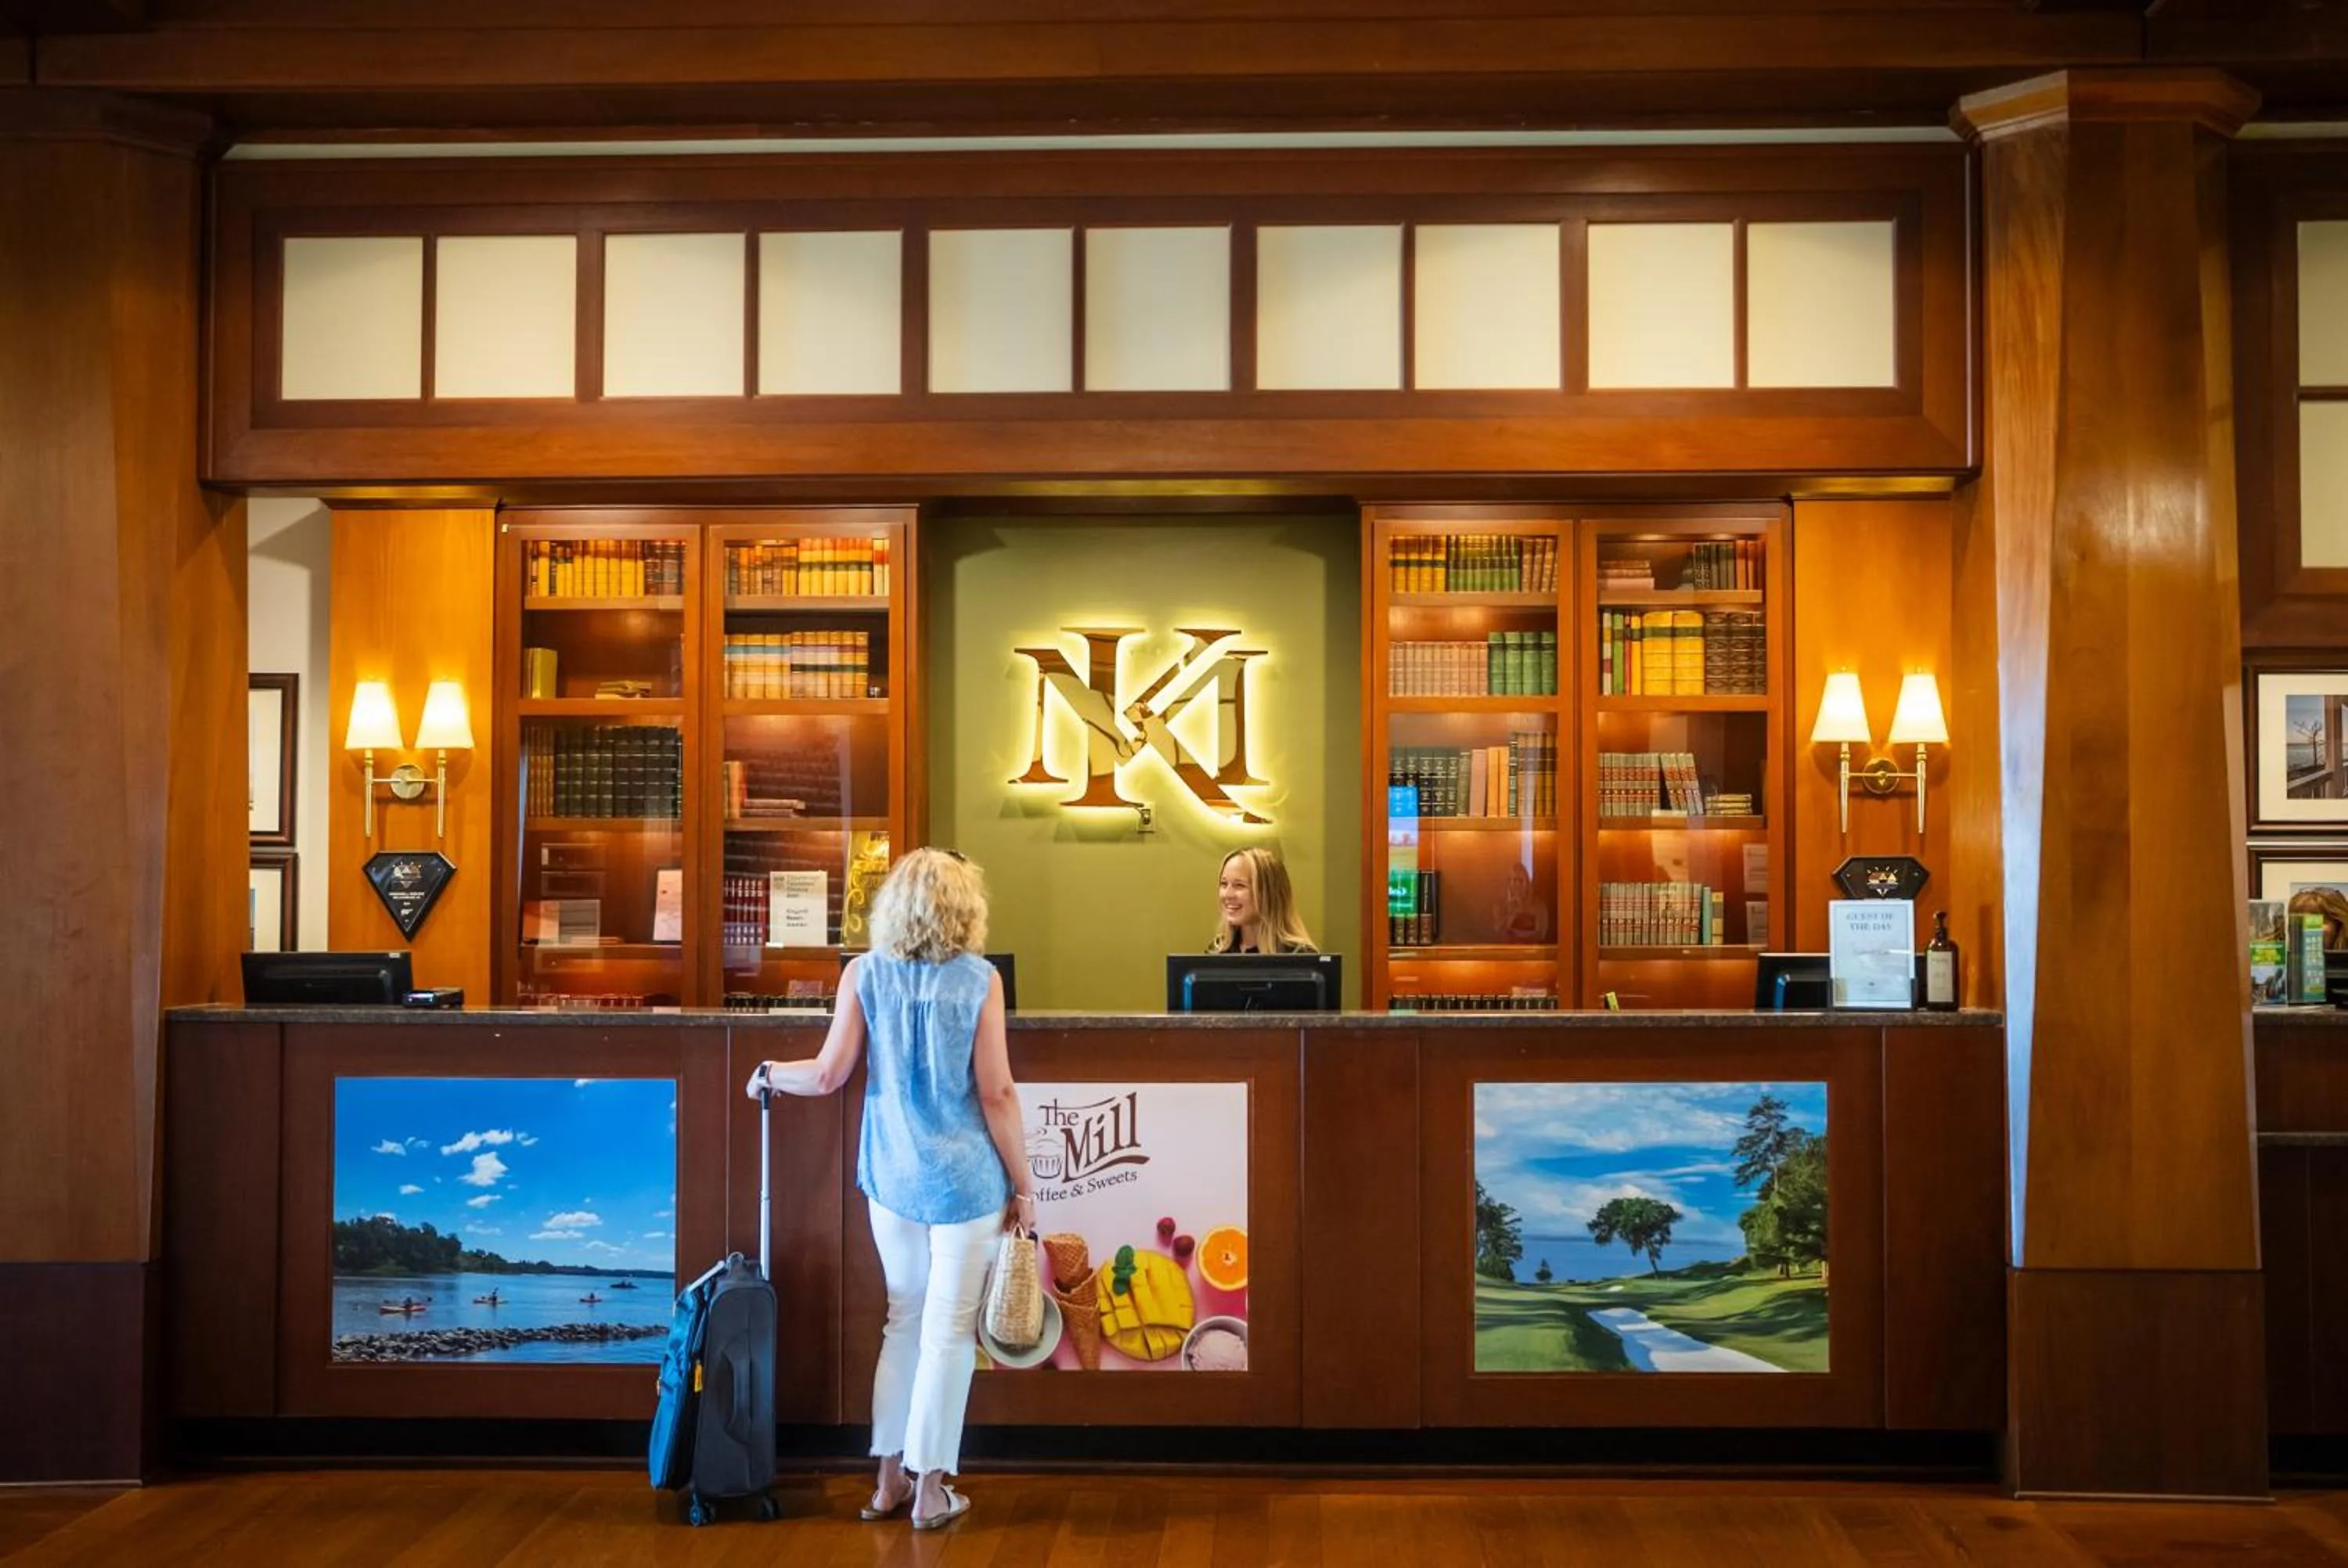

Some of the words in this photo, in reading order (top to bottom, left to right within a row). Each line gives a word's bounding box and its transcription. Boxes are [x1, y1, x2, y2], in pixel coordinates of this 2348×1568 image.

[1038, 1098, 1080, 1126] The
[1060, 1091, 1141, 1184] Mill
[1035, 1187, 1068, 1202] offee
[1070, 1184, 1084, 1197] &
[1086, 1171, 1138, 1194] Sweets
